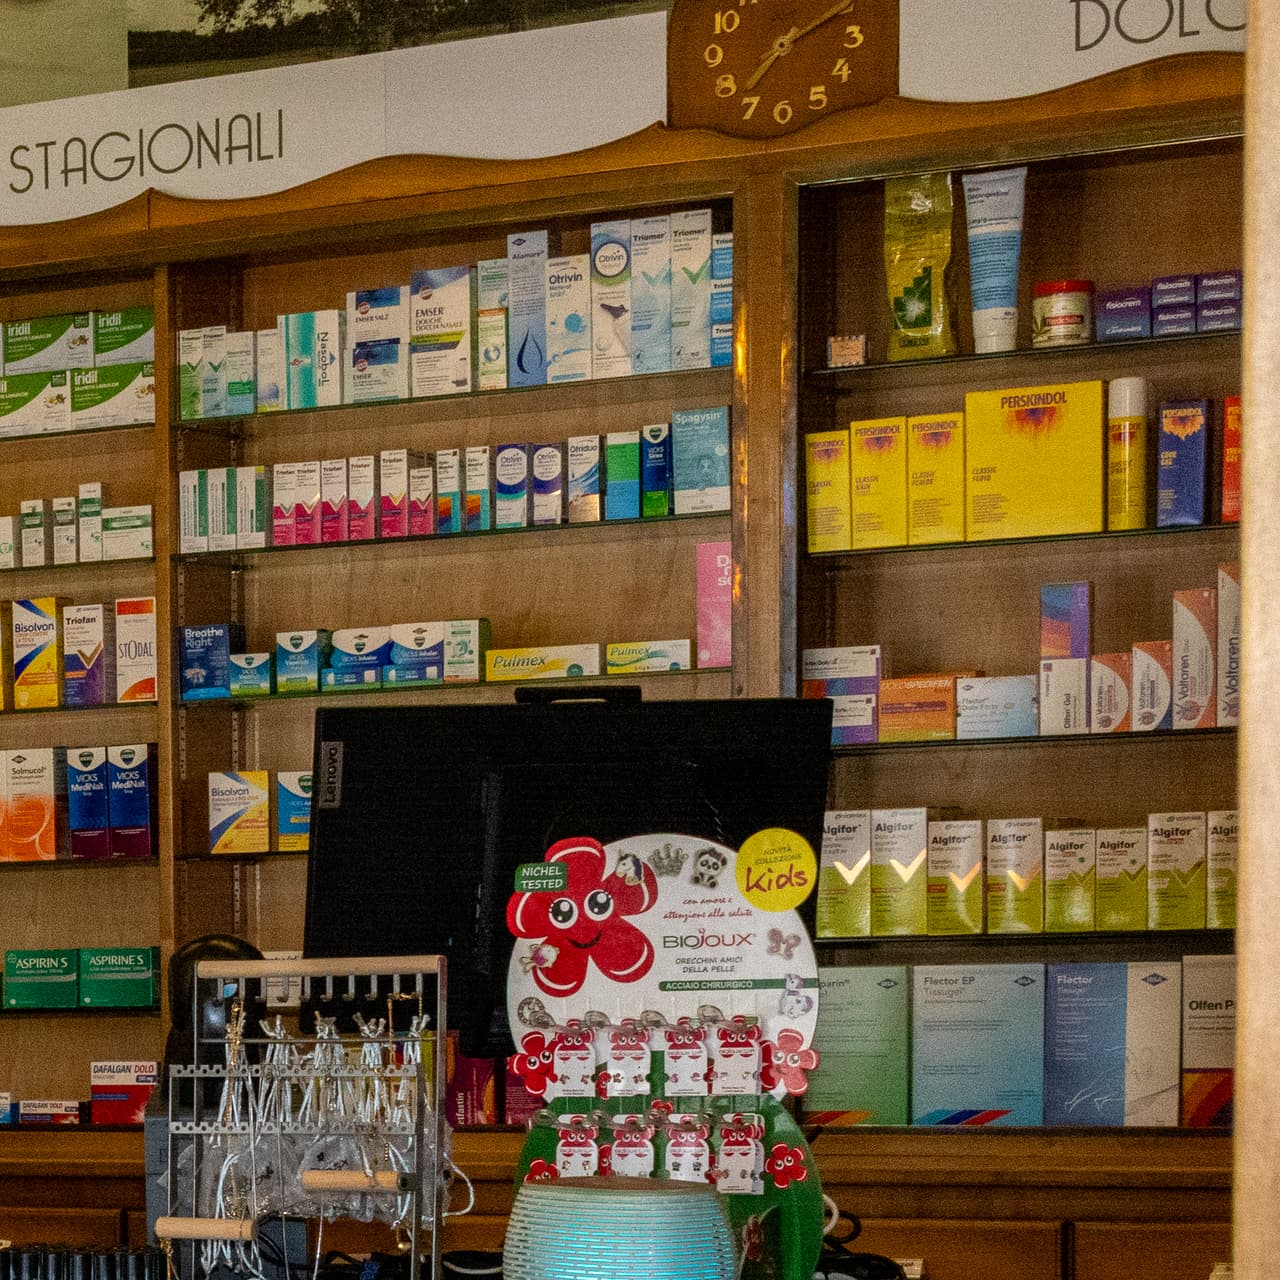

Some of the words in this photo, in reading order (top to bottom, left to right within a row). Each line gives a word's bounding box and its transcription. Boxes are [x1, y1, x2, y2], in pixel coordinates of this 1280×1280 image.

[714, 11, 740, 33] 10
[845, 25, 864, 48] 3
[705, 44, 723, 66] 9
[832, 58, 851, 82] 4
[715, 75, 737, 98] 8
[808, 86, 827, 111] 5
[741, 98, 759, 119] 7
[774, 102, 792, 124] 6
[9, 109, 284, 194] STAGIONALI
[673, 227, 707, 238] Triomer
[549, 273, 582, 285] Otrivin
[415, 307, 444, 317] EMSER
[1106, 300, 1141, 311] fisiocrem
[8, 323, 30, 336] iridil
[75, 371, 97, 384] iridil
[1001, 391, 1068, 409] PERSKINDOL
[855, 424, 901, 436] PERSKINDOL
[15, 621, 54, 633] Bisolvon
[66, 616, 96, 626] Triofan
[185, 628, 223, 639] Breathe
[185, 637, 212, 648] Right
[610, 645, 650, 658] Pulmex
[492, 654, 547, 669] Pulmex
[1178, 653, 1189, 700] Voltaren
[323, 747, 338, 803] Lenovo
[875, 821, 912, 834] Algifor
[931, 834, 970, 847] Algifor
[521, 866, 562, 877] NICHEL
[521, 879, 563, 890] TESTED
[16, 957, 57, 970] ASPIRIN
[60, 956, 68, 968] S
[701, 980, 752, 990] CHIRURGICO
[93, 1065, 131, 1076] DAFALGAN
[134, 1064, 154, 1074] DOLO
